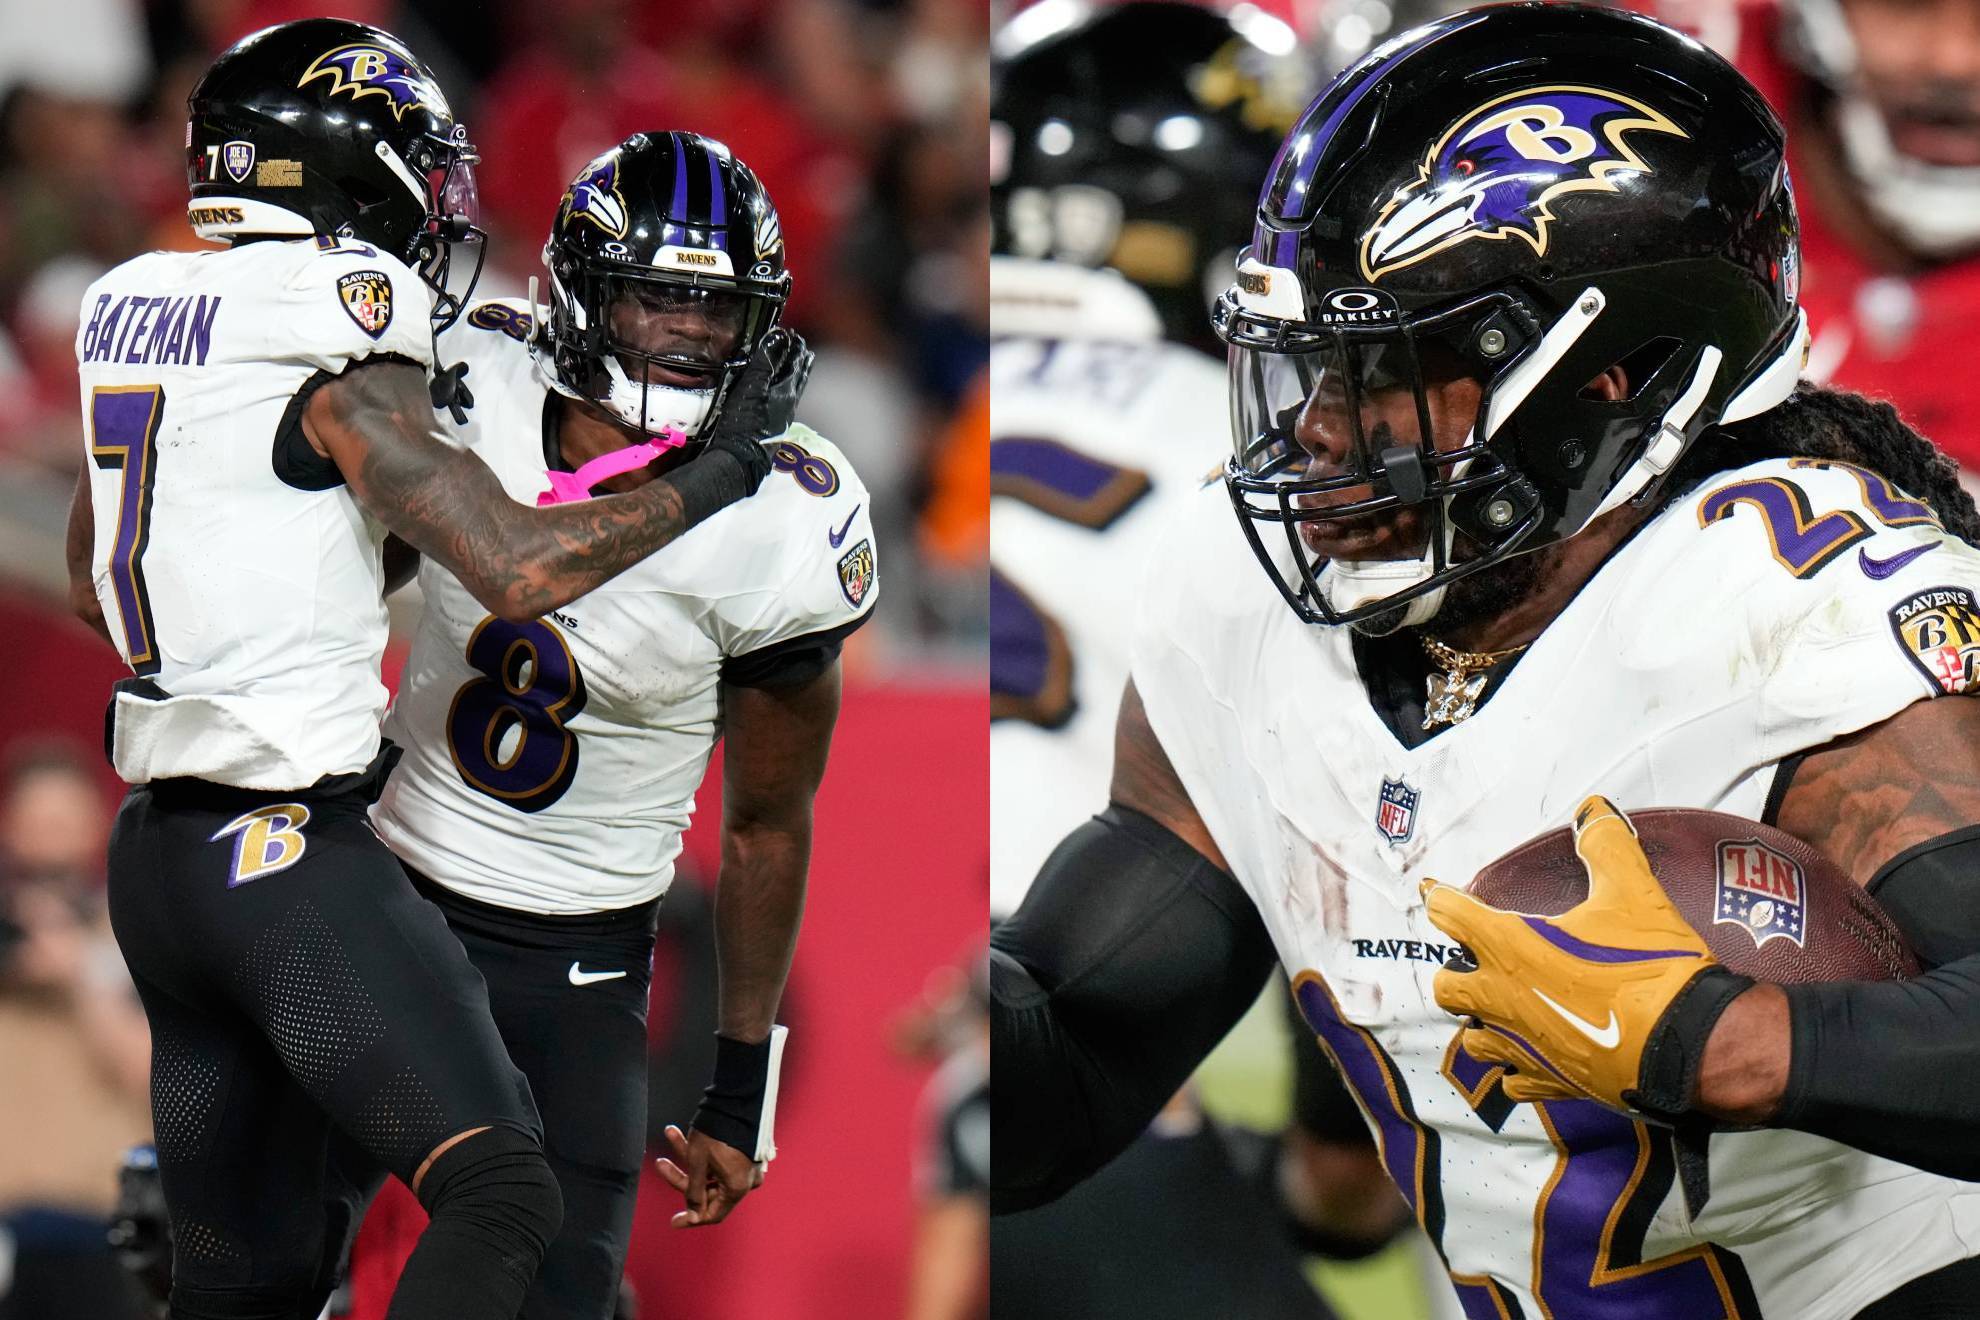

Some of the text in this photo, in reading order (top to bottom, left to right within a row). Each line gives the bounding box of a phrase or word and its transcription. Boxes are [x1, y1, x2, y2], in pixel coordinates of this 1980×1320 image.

[206, 145, 220, 180] 7
[229, 146, 240, 159] JOE
[676, 252, 717, 266] RAVENS
[340, 272, 386, 287] RAVENS
[83, 293, 222, 366] BATEMAN
[1322, 309, 1396, 323] OAKLEY
[771, 441, 840, 498] 8
[90, 384, 166, 677] 7
[1895, 591, 1969, 622] RAVENS
[445, 614, 588, 813] 8
[1379, 802, 1407, 834] NFL
[1726, 847, 1798, 900] NFL
